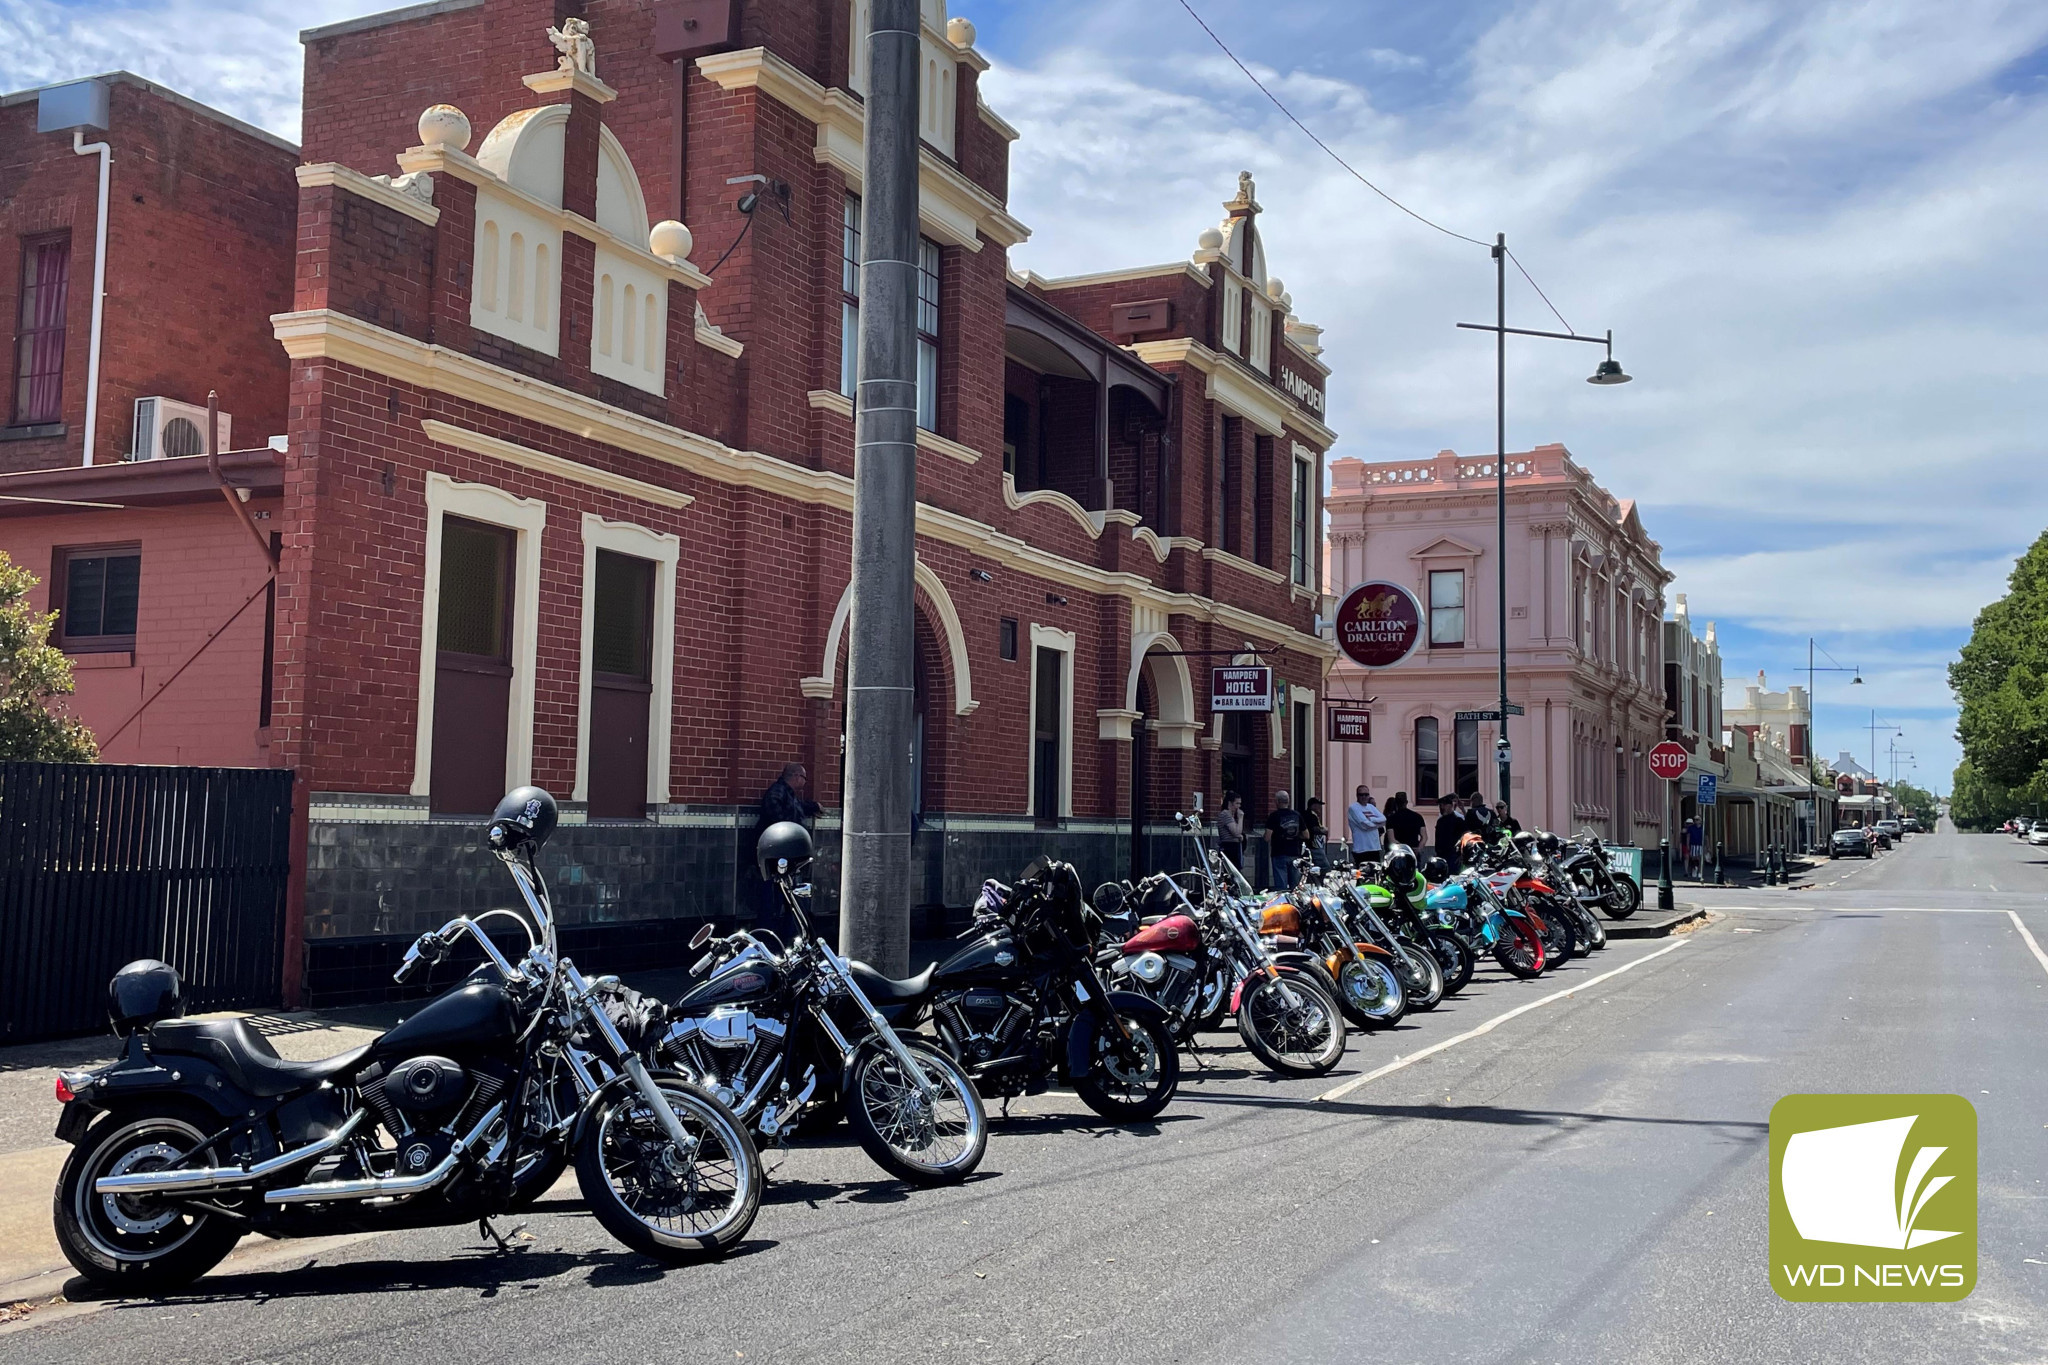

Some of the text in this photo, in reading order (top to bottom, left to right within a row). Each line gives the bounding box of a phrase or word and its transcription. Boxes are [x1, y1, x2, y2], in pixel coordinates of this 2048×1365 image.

[1281, 365, 1325, 414] HAMPDEN
[1344, 620, 1408, 632] CARLTON
[1347, 632, 1405, 643] DRAUGHT
[1223, 670, 1259, 680] HAMPDEN
[1226, 681, 1256, 693] HOTEL
[1221, 698, 1266, 706] BAR & LOUNGE
[1337, 714, 1368, 724] HAMPDEN
[1482, 712, 1494, 720] ST
[1340, 724, 1364, 735] HOTEL
[1651, 753, 1686, 768] STOP
[1700, 775, 1709, 786] P
[1614, 852, 1633, 867] OW
